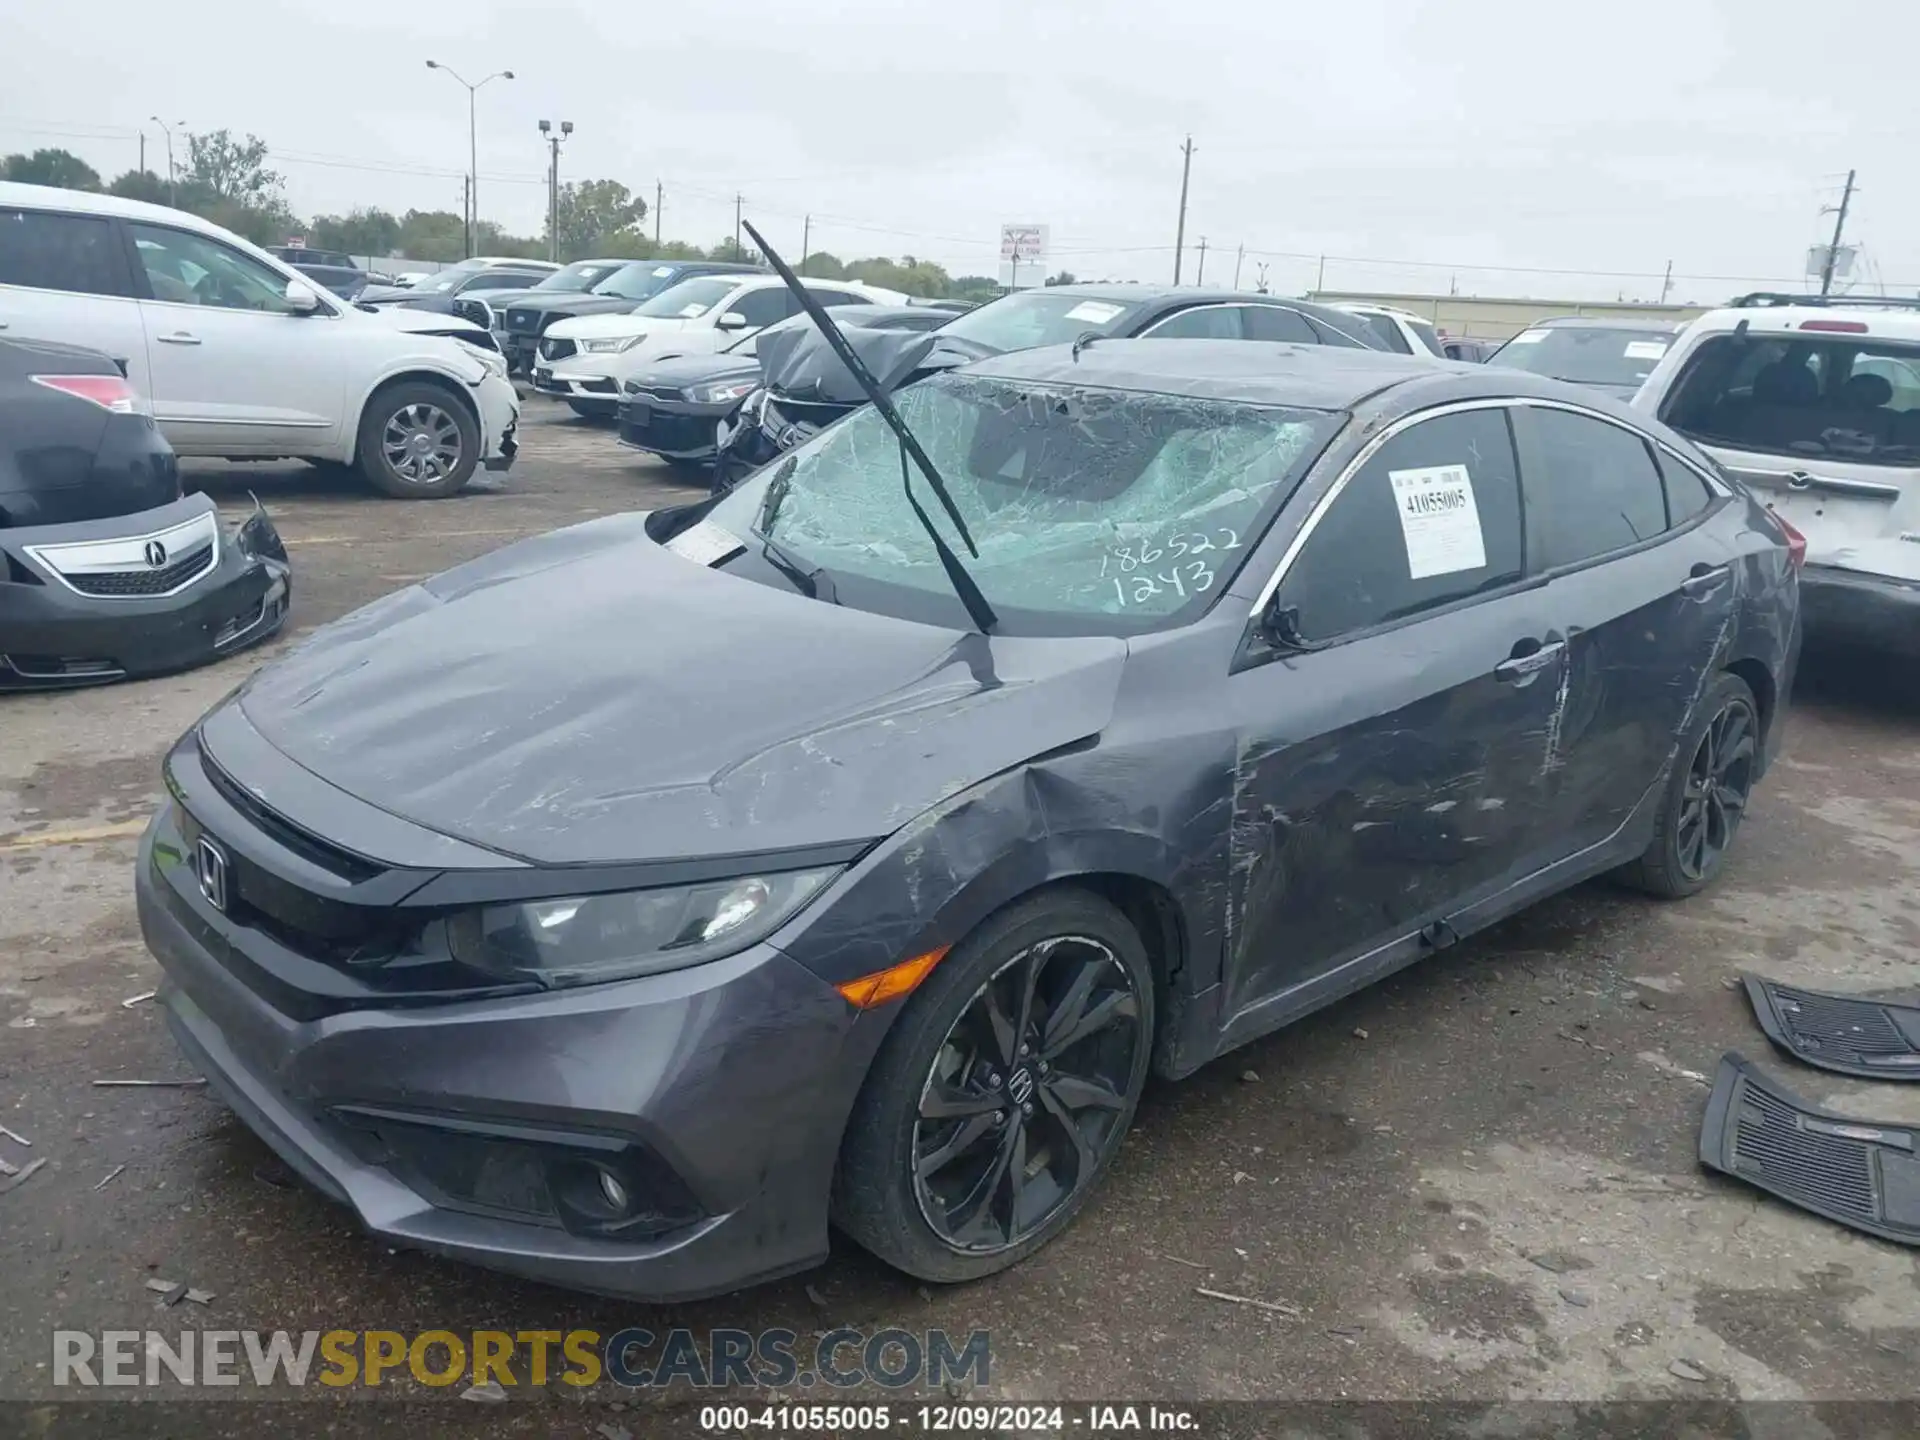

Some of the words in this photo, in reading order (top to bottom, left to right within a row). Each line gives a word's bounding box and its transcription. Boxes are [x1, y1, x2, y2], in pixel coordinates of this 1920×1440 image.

[1407, 489, 1466, 513] 41055005
[1100, 527, 1243, 577] 186522
[1114, 561, 1214, 607] 1243
